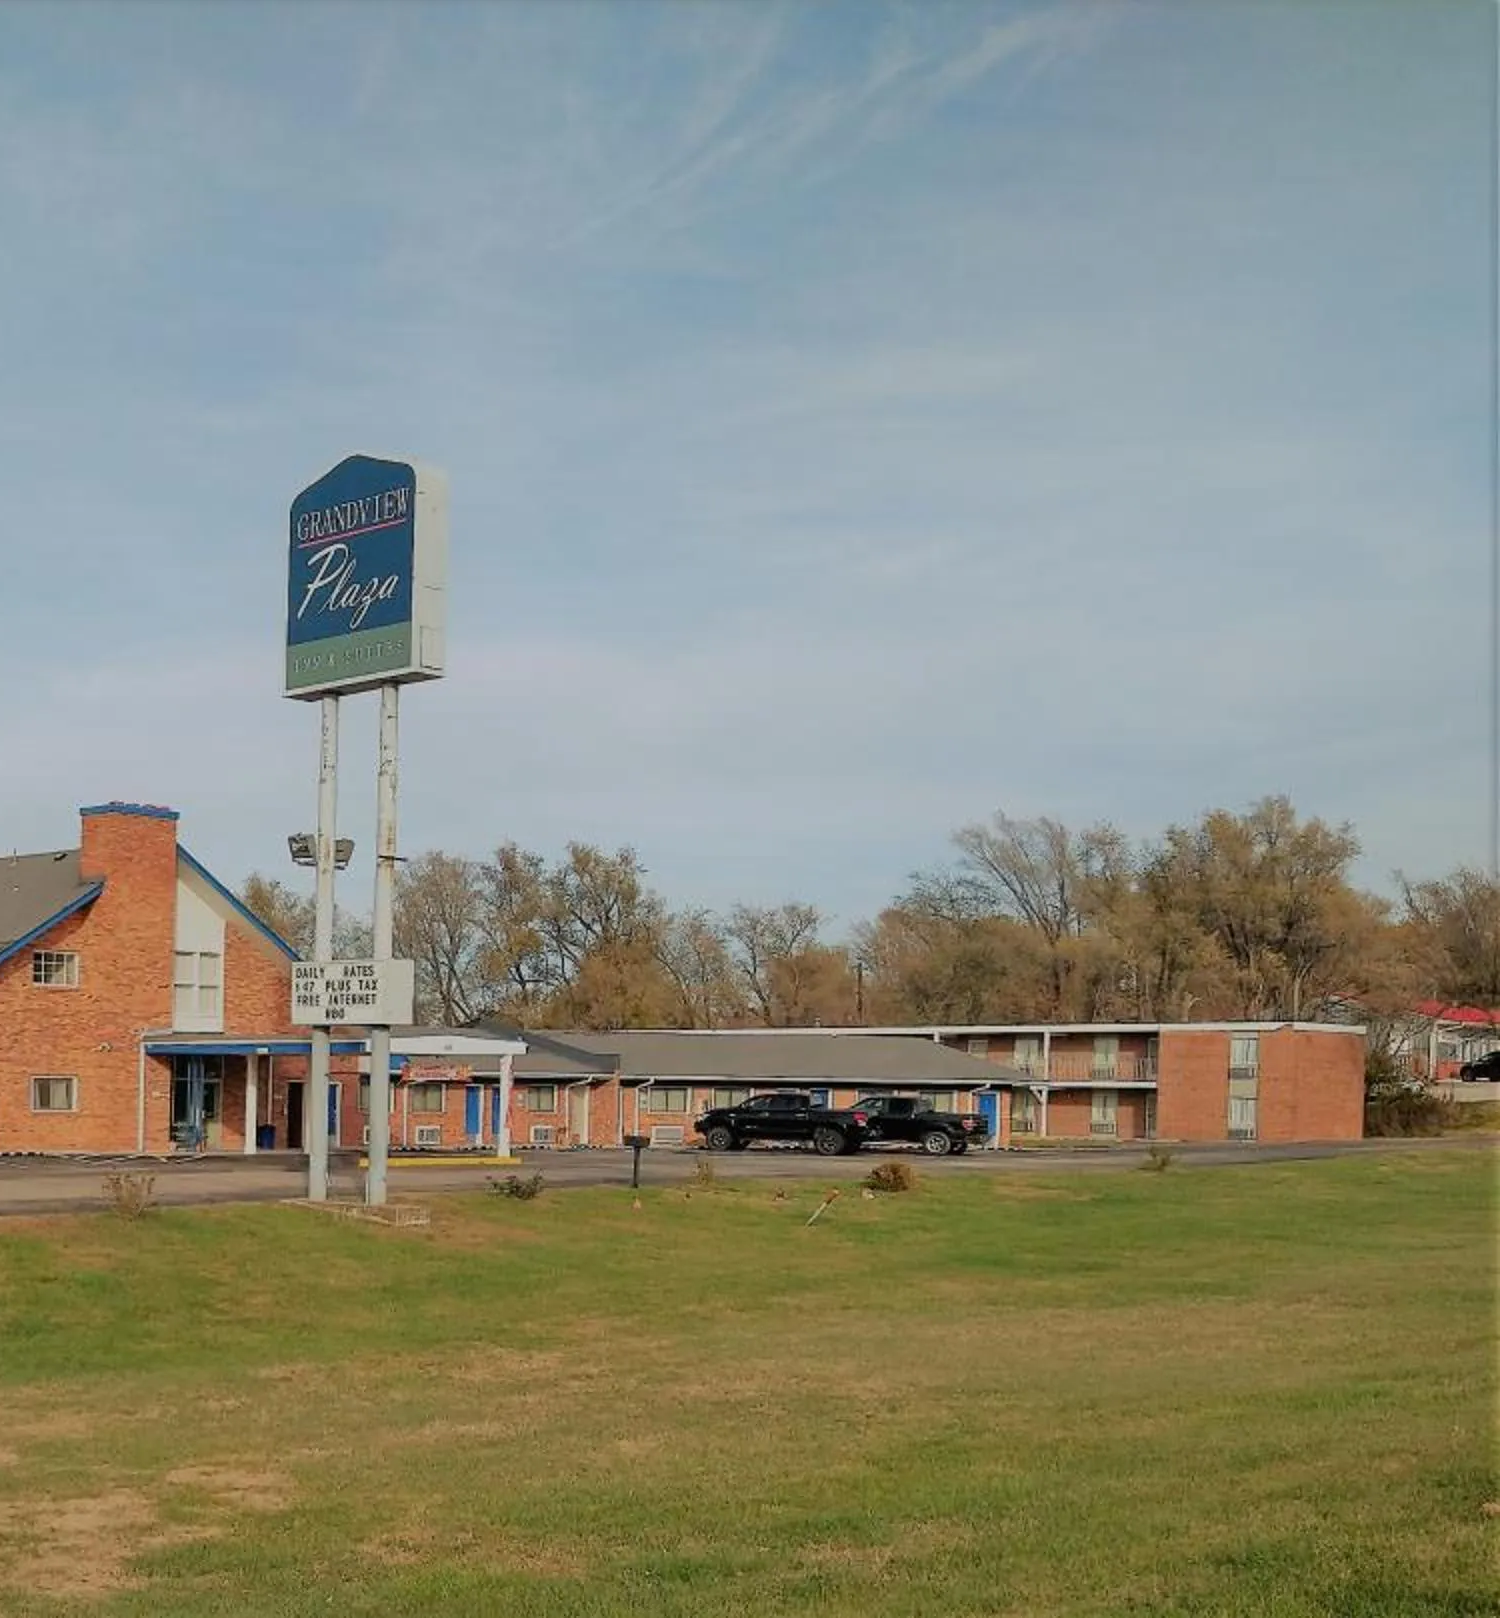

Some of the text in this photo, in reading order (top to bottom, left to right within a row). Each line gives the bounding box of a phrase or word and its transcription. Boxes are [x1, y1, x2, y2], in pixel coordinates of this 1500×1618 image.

[297, 487, 409, 541] GRANDVIEW
[297, 543, 399, 630] Plaza
[296, 965, 375, 979] DAILY RATES
[325, 980, 351, 992] PLUS
[358, 979, 379, 991] TAX
[297, 993, 377, 1007] FREE INTERNET
